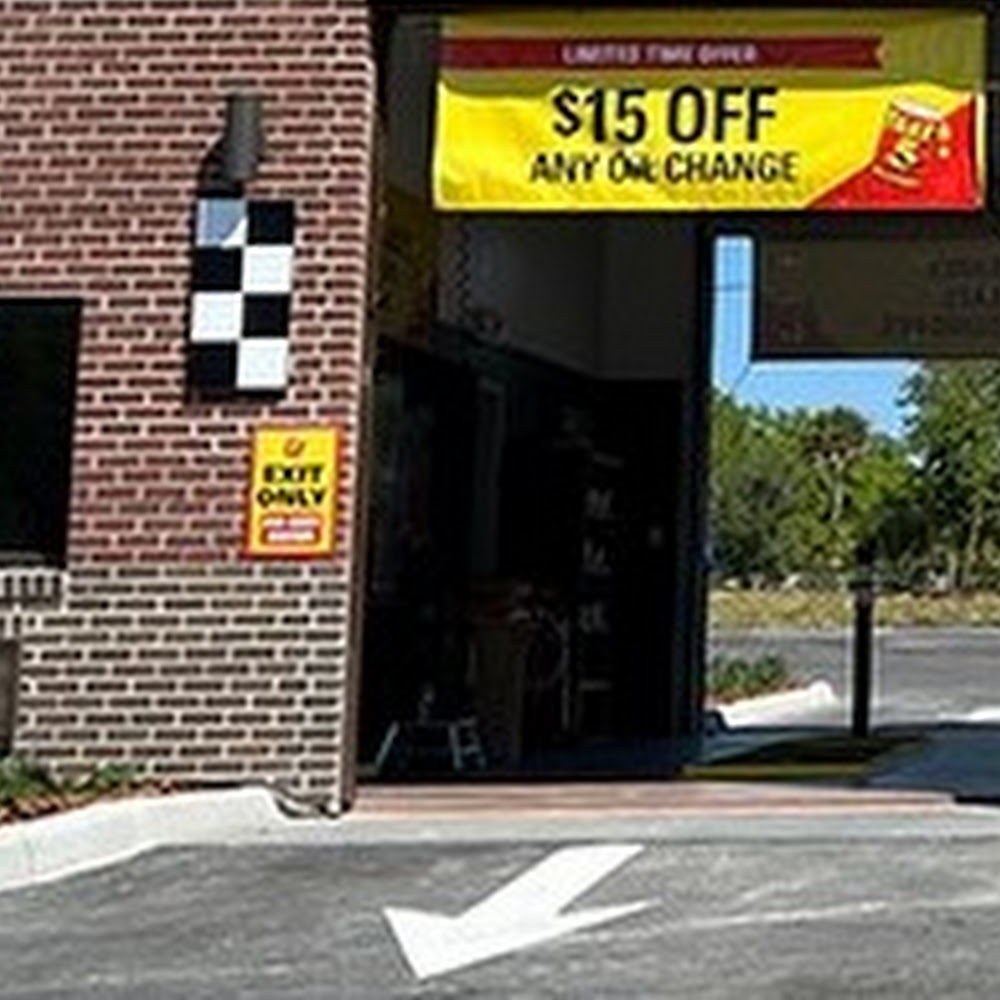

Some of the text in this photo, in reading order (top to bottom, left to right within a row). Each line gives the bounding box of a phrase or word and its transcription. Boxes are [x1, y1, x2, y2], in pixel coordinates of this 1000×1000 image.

[552, 84, 778, 144] $15 OFF
[530, 152, 600, 184] ANY
[663, 151, 800, 185] CHANGE
[263, 464, 325, 483] EXIT
[257, 487, 327, 508] ONLY
